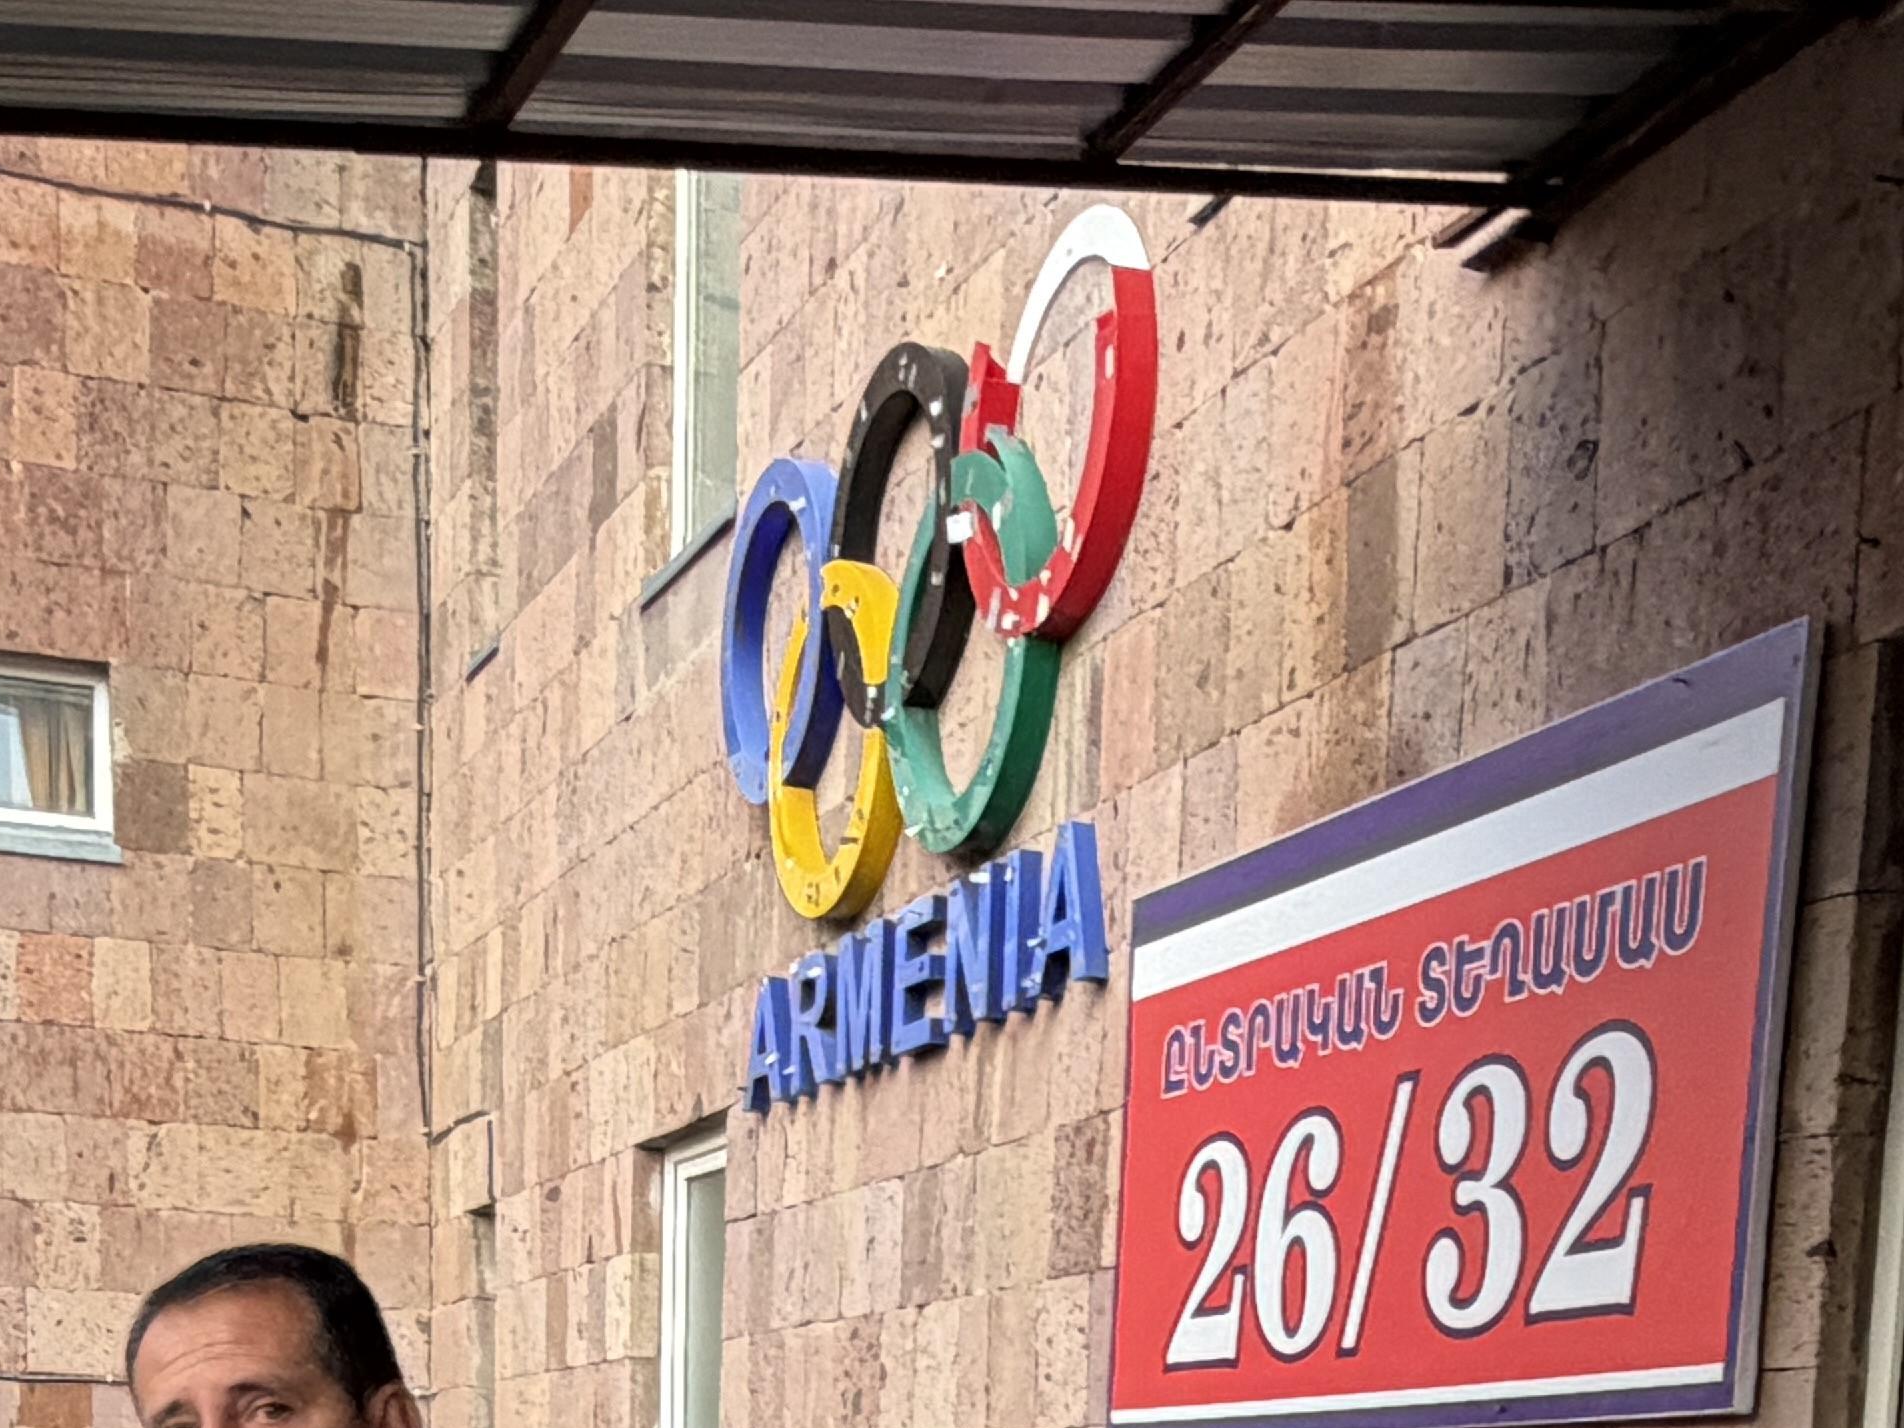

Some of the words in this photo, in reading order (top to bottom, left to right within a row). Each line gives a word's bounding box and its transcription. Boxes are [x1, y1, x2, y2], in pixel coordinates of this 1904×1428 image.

[742, 820, 1108, 1113] ARMENIA
[1160, 960, 1404, 1099] ԸՆՏՐԱԿԱՆ
[1415, 855, 1708, 1027] ՏԵՂԱՄԱՍ
[1163, 1018, 1656, 1374] 26/32
